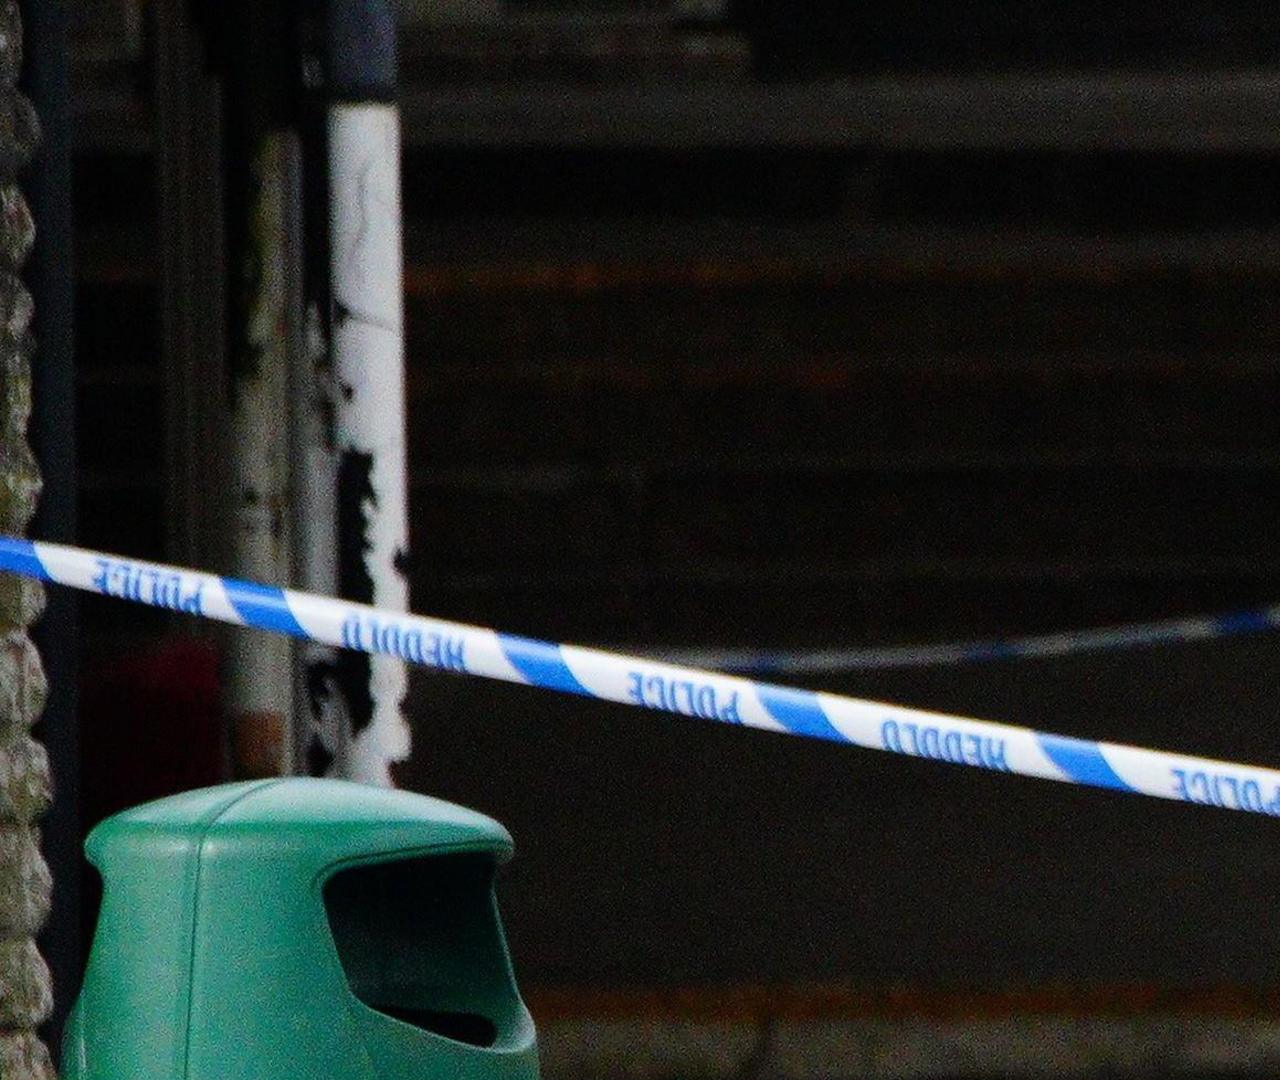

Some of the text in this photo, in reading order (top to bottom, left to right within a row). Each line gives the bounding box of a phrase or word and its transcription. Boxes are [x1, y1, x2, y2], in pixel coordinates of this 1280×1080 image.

[91, 558, 204, 617] POLICE
[342, 614, 470, 673] HEDDLU
[628, 672, 742, 725] POLICE
[880, 719, 1009, 774] HEDDLU
